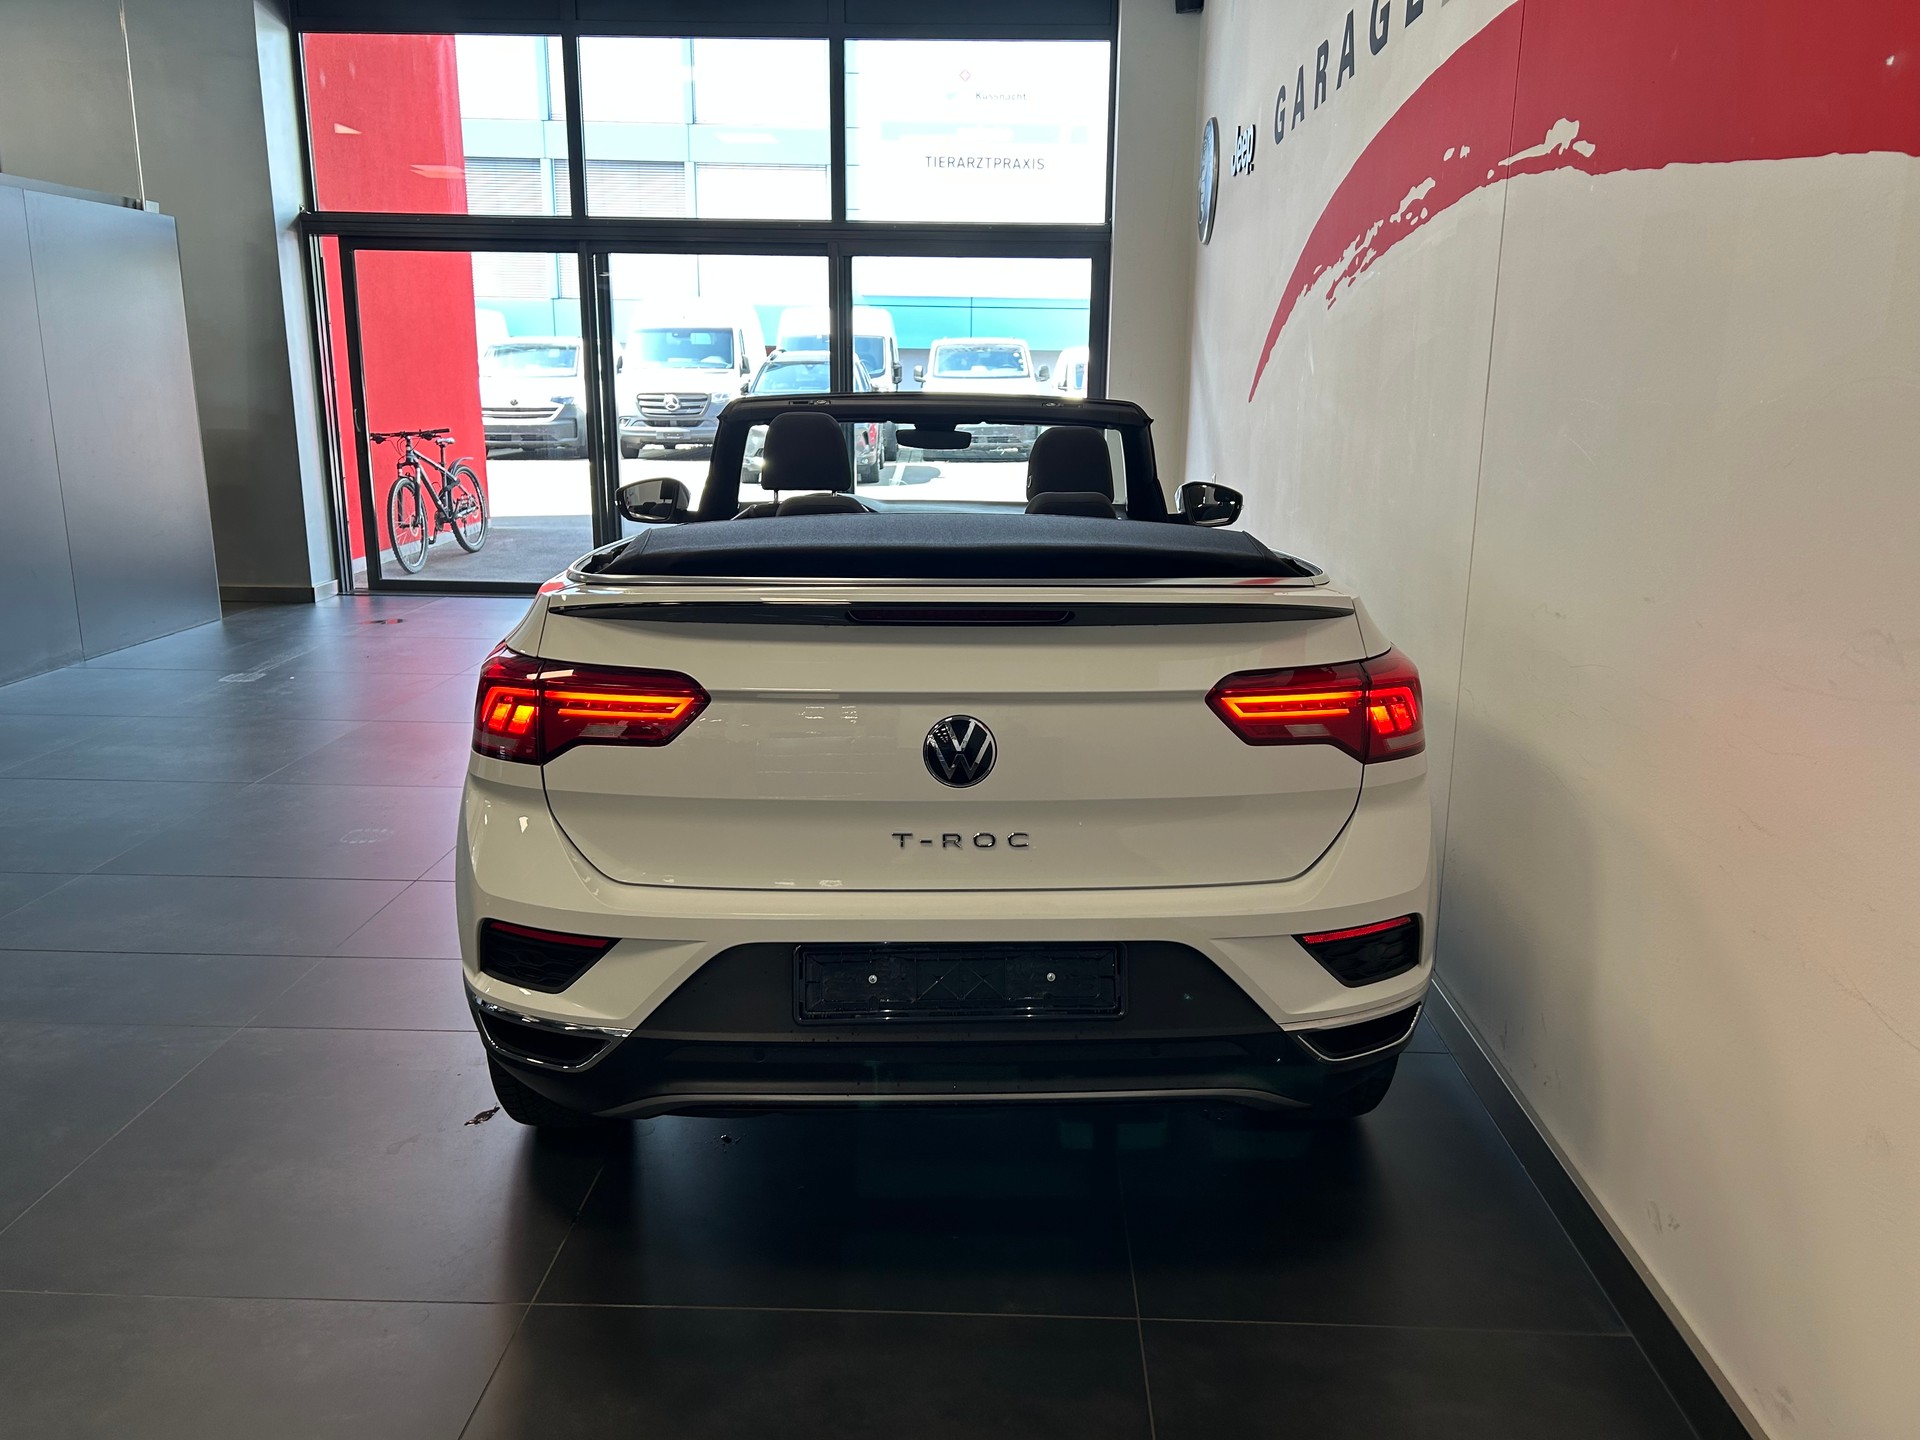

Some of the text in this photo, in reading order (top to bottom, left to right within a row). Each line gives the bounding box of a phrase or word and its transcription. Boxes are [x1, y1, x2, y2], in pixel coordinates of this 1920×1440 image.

[1274, 0, 1424, 145] GARAG
[925, 155, 1045, 170] TIERARZTPRAXIS
[1231, 124, 1256, 176] Jeep
[892, 832, 1030, 848] T-ROC
